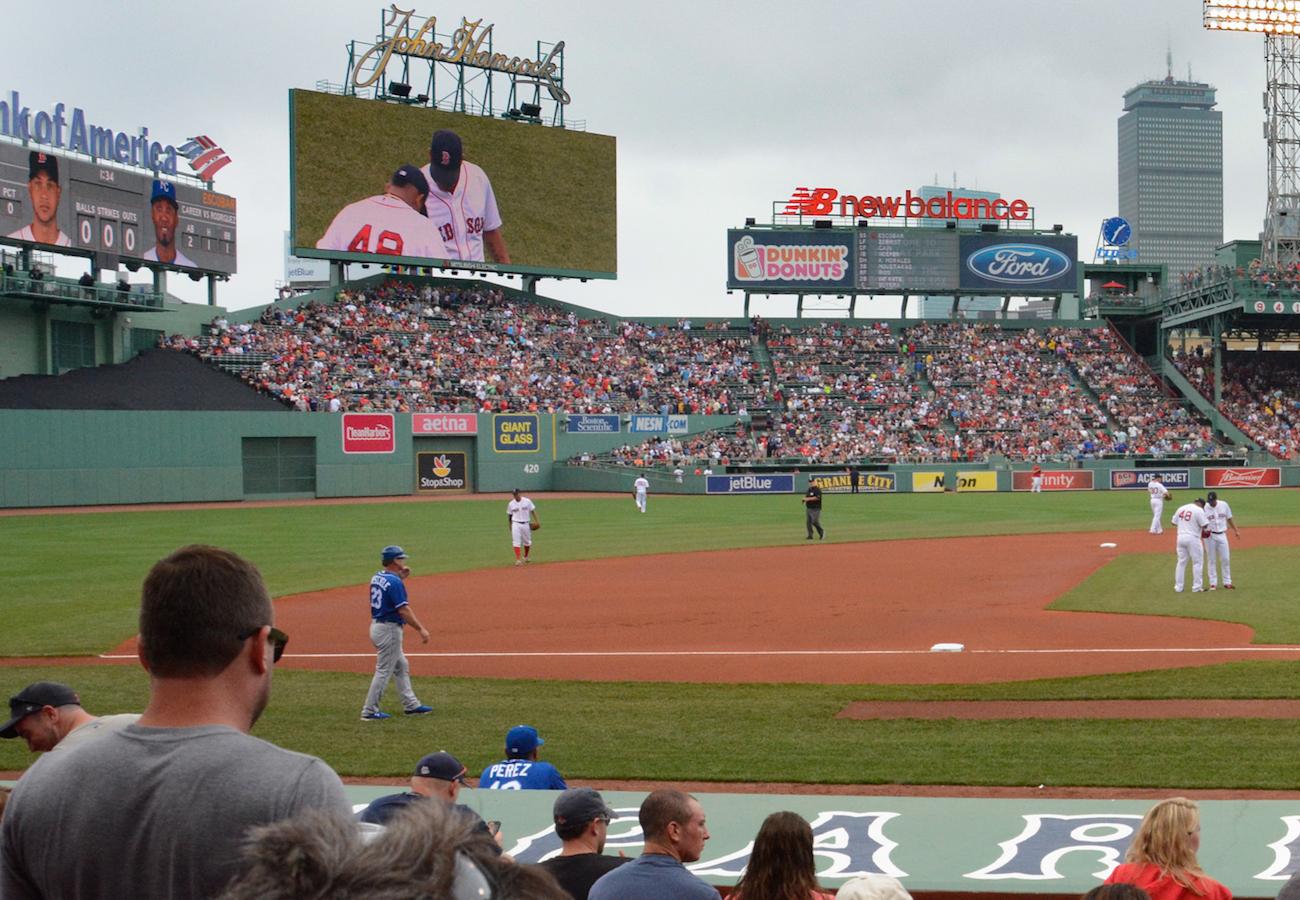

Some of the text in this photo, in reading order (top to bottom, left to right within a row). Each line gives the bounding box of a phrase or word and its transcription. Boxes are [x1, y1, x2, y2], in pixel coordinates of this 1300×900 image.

[353, 4, 571, 105] John Hancock
[34, 102, 67, 147] of
[69, 107, 177, 175] America
[3, 187, 16, 198] PCT
[7, 202, 14, 215] 0
[75, 201, 137, 222] BALLS STRIKES OUTS
[841, 195, 900, 217] new
[906, 190, 1029, 220] balance
[81, 220, 91, 244] 0
[103, 224, 113, 248] 0
[125, 228, 135, 251] 0
[188, 236, 193, 248] 2
[767, 247, 845, 262] DUNKIN'
[767, 263, 842, 278] DONUTS
[988, 250, 1050, 279] Ford
[1276, 303, 1282, 311] 4
[423, 416, 467, 430] aetna
[502, 422, 531, 432] GIANT
[577, 422, 613, 431] Scientific
[582, 416, 604, 425] Boston
[636, 417, 663, 431] NESN
[500, 434, 533, 444] GLASS
[524, 465, 539, 473] 420
[729, 476, 772, 489] jetBlue
[814, 475, 893, 488] GRANIE CITY
[934, 477, 977, 487] Non
[1179, 510, 1192, 521] 48
[490, 763, 532, 778] PEREZ
